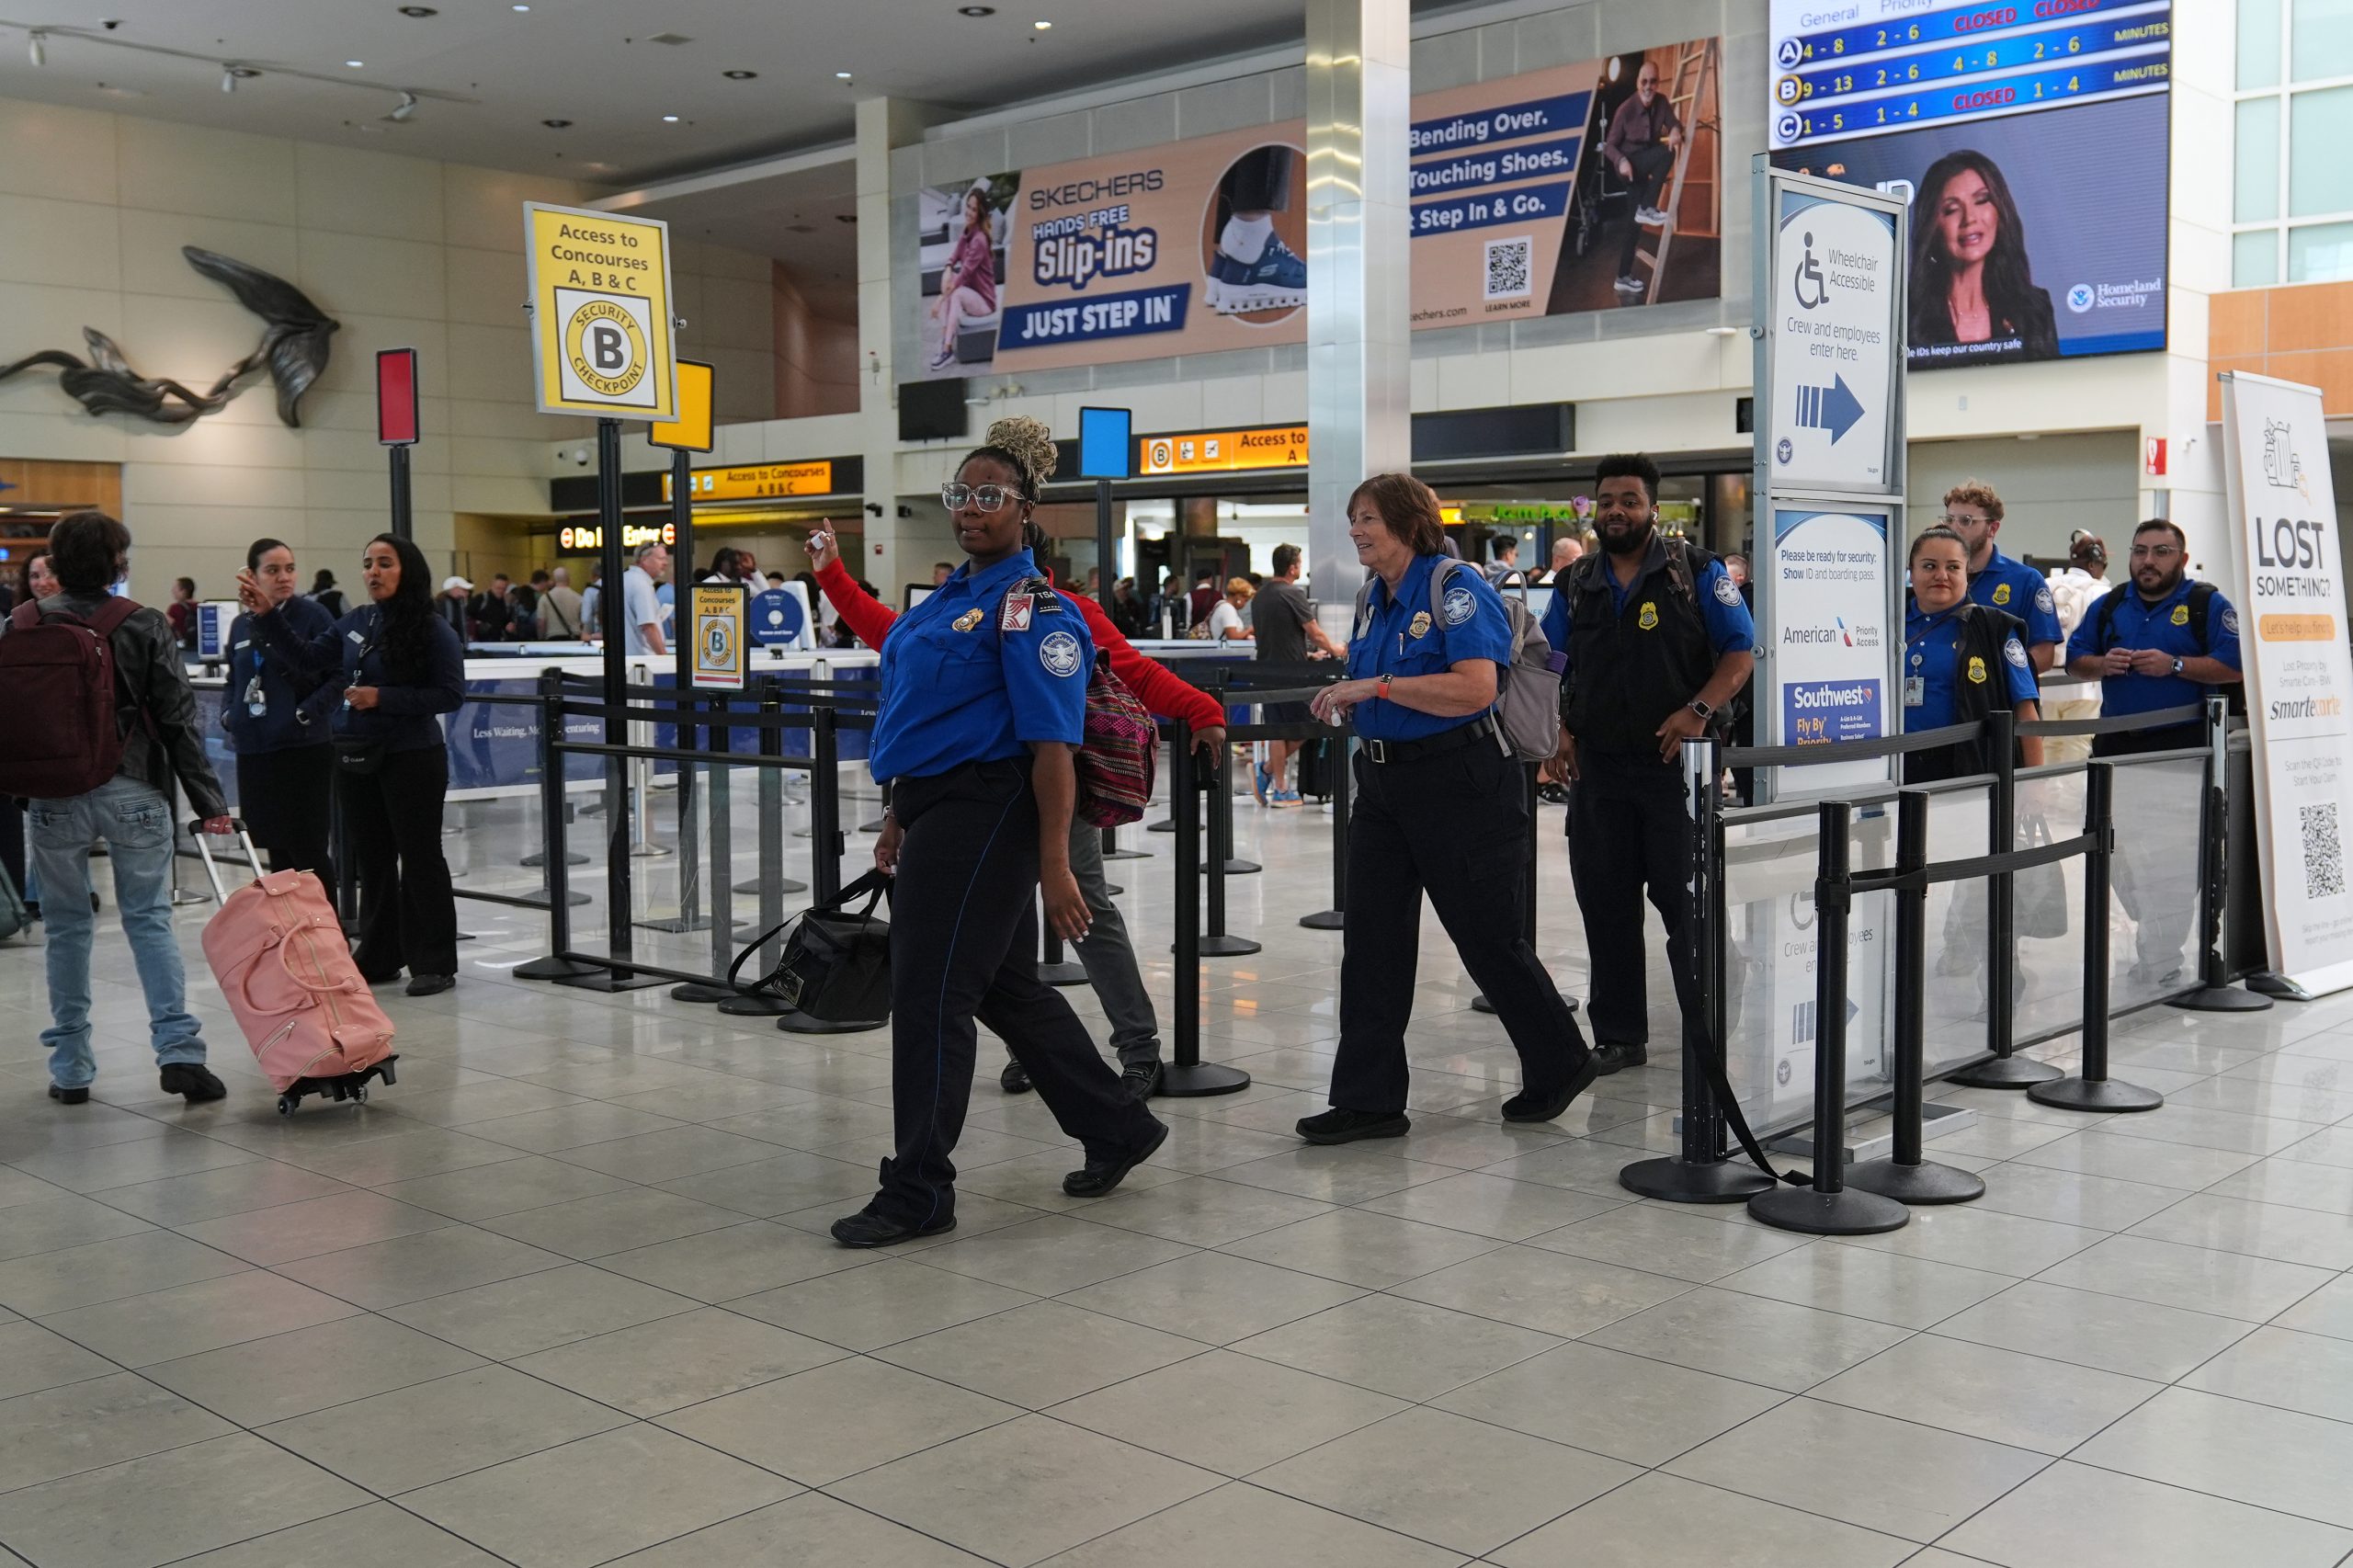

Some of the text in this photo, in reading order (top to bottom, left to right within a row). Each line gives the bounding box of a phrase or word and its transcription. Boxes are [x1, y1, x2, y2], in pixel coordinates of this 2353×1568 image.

[1801, 5, 1859, 28] General
[1779, 42, 1797, 62] A
[1803, 44, 1813, 58] 4
[1834, 38, 1845, 53] 8
[1877, 30, 1887, 46] 2
[1908, 24, 1920, 40] 6
[1953, 6, 2017, 32] CLOSED
[2034, 0, 2100, 17] CLOSED
[1781, 81, 1796, 99] B
[1802, 83, 1813, 97] 9
[1834, 75, 1853, 92] 13
[1877, 70, 1887, 85] 2
[1908, 64, 1919, 79] 6
[1953, 56, 1963, 72] 4
[1986, 51, 1997, 66] 8
[2034, 42, 2044, 59] 2
[2068, 36, 2080, 52] 6
[2114, 22, 2169, 42] MINUTES
[1779, 119, 1794, 136] C
[1803, 119, 1813, 133] 1
[1834, 113, 1844, 130] 5
[1877, 108, 1886, 123] 1
[1908, 102, 1918, 117] 4
[1953, 87, 2016, 111] CLOSED
[2034, 82, 2043, 98] 1
[2068, 75, 2079, 92] 4
[2114, 63, 2168, 83] MINUTES
[1410, 108, 1549, 148] Bending Over.
[1410, 149, 1569, 190] Touching Shoes.
[1030, 169, 1164, 210] SKECHERS
[1033, 204, 1129, 241] HANDS FREE
[1419, 205, 1463, 230] Step
[1469, 201, 1487, 221] In
[1493, 198, 1507, 218] &
[1513, 193, 1546, 213] Go.
[559, 223, 638, 248] Access to
[551, 244, 648, 271] Concourses
[1038, 230, 1154, 284] Slip-ins
[1828, 248, 1879, 272] Wheelchair
[569, 269, 637, 291] A, B & C
[1829, 270, 1875, 292] Accessible
[2097, 278, 2161, 295] Homeland
[1484, 300, 1530, 313] LEARN MORE
[2097, 293, 2148, 308] Security
[575, 304, 636, 331] SECURITY
[1021, 307, 1077, 340] JUST
[1082, 299, 1139, 332] STEP
[1410, 307, 1467, 322] echers.com
[1787, 316, 1881, 345] Crew and employees
[594, 326, 624, 369] B
[1810, 342, 1859, 361] enter here.
[1916, 347, 1929, 357] IDs
[1931, 346, 1951, 357] keep
[1952, 345, 1967, 354] our
[1969, 342, 2002, 353] country
[2004, 338, 2022, 349] safe
[574, 357, 642, 392] CHECKPOINT
[1241, 432, 1305, 448] Access to
[1157, 449, 1165, 461] B
[1288, 449, 1297, 462] A
[727, 467, 825, 482] Access to Concourses
[756, 484, 764, 495] A
[769, 483, 775, 494] B
[788, 483, 794, 494] C
[574, 527, 596, 549] Do
[2256, 517, 2324, 569] LOST
[1781, 550, 1877, 565] Please be ready for security:
[1783, 568, 1876, 582] Show ID and boarding pass.
[2257, 575, 2331, 597] SOMETHING?
[699, 596, 735, 604] Concourses
[1036, 591, 1056, 599] TSA
[712, 631, 723, 652] B
[1783, 626, 1836, 643] American
[1856, 626, 1878, 637] Priority
[1856, 638, 1880, 647] Access
[1794, 684, 1864, 709] Southwest
[473, 728, 493, 739] Less
[564, 722, 600, 734] enturing
[1797, 718, 1811, 735] Fly
[1784, 941, 1807, 958] Crew
[1848, 927, 1873, 946] oyees
